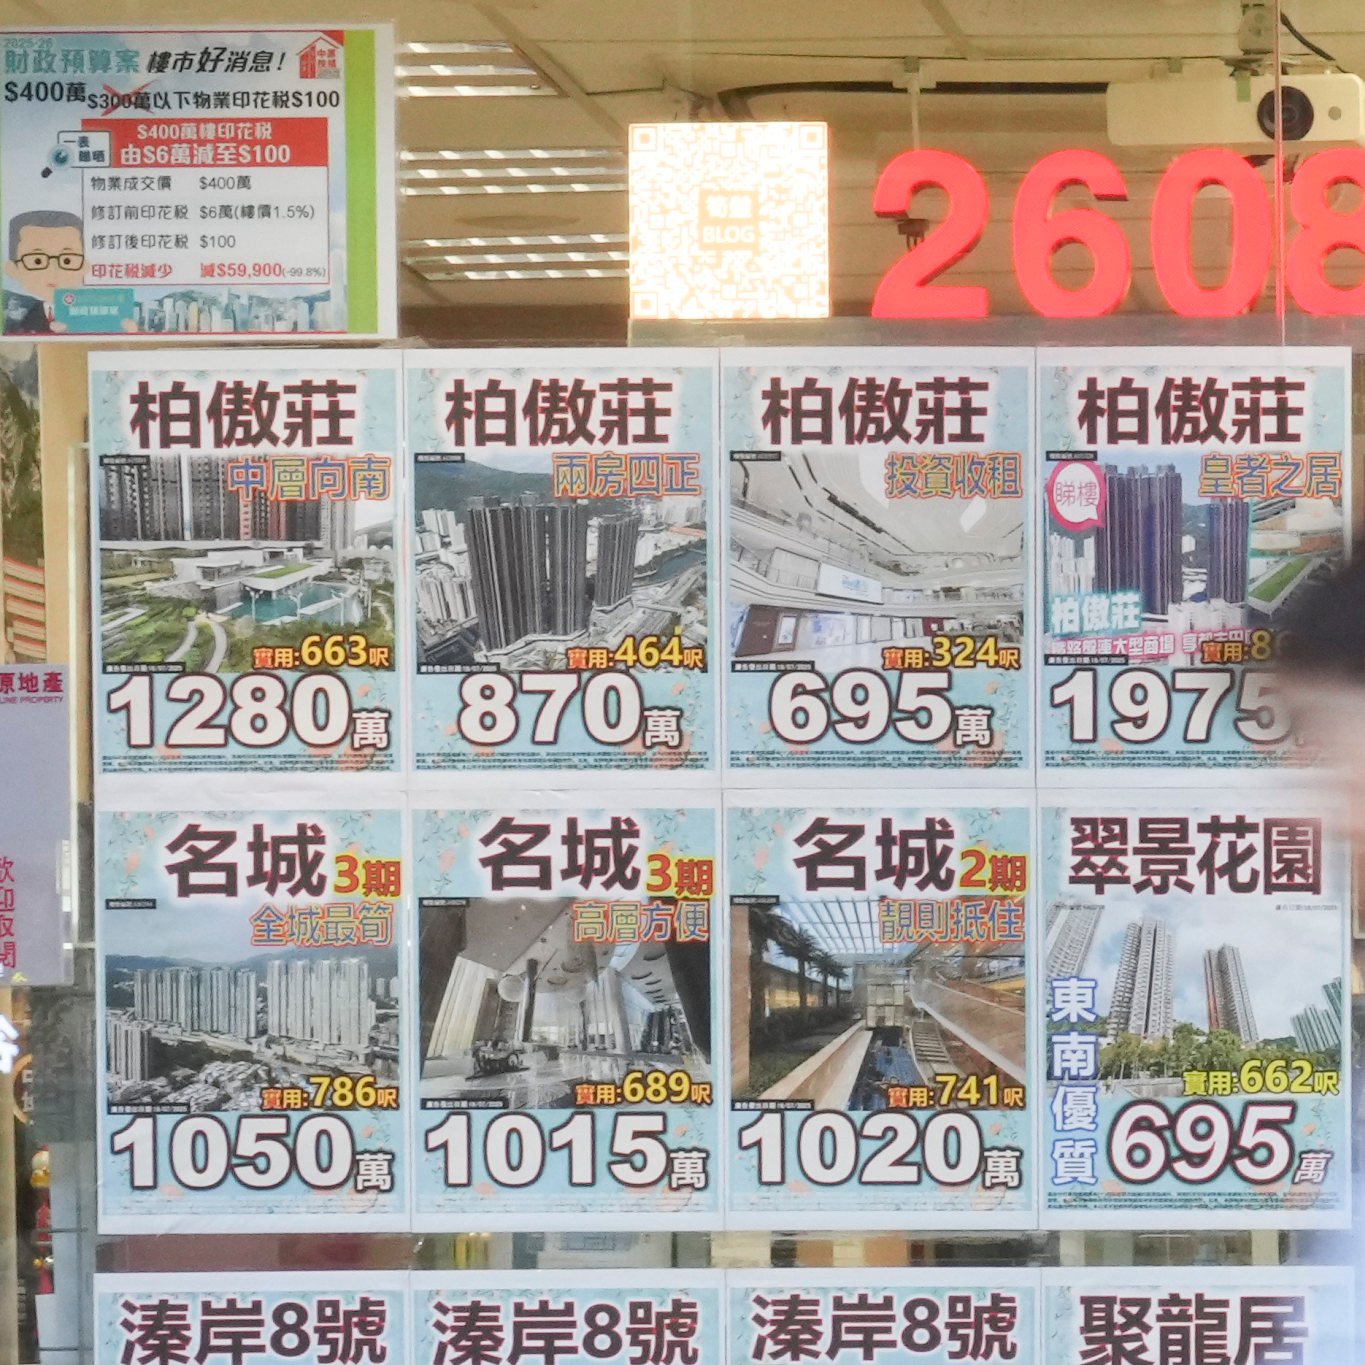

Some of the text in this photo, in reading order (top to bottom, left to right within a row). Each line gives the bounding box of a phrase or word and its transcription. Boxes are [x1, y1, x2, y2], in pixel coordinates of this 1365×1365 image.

[4, 48, 286, 75] 財政預算案 樓市好消息!
[4, 81, 86, 103] $400萬
[90, 176, 251, 191] 物業成交價 $400萬
[200, 235, 235, 248] $100
[703, 226, 756, 243] BLOG
[129, 379, 357, 449] 柏傲莊
[445, 378, 673, 448] 柏傲莊
[761, 376, 989, 444] 柏傲莊
[1077, 376, 1306, 444] 柏傲莊
[227, 455, 392, 501] 中層向南
[552, 452, 702, 497] 兩房四正
[885, 453, 1023, 499] 投資收租
[1199, 452, 1343, 499] 皇者之居
[253, 634, 390, 670] 實用:663呎
[567, 634, 703, 670] 實用:464呎
[882, 635, 1020, 669] 實用:324呎
[108, 672, 391, 749] 1280萬
[458, 672, 682, 747] 870萬
[767, 668, 992, 747] 695萬
[163, 822, 401, 900] 名城3期
[477, 816, 714, 897] 名城3期
[794, 816, 1026, 894] 名城2期
[1068, 815, 1323, 896] 翠景花園
[250, 904, 394, 946] 全城最筍
[573, 901, 709, 943] 高層方便
[261, 1075, 398, 1111] 實用:786呎
[576, 1072, 711, 1107] 實用:689呎
[888, 1074, 1023, 1108] 實用:741呎
[1051, 978, 1099, 1185] 東南優質
[1182, 1059, 1340, 1100] 實用:662呎
[110, 1112, 394, 1191] 1050萬
[425, 1111, 708, 1191] 1015萬
[739, 1110, 1022, 1188] 1020萬
[1109, 1100, 1332, 1186] 695萬
[750, 1293, 1019, 1363] 溱岸8號
